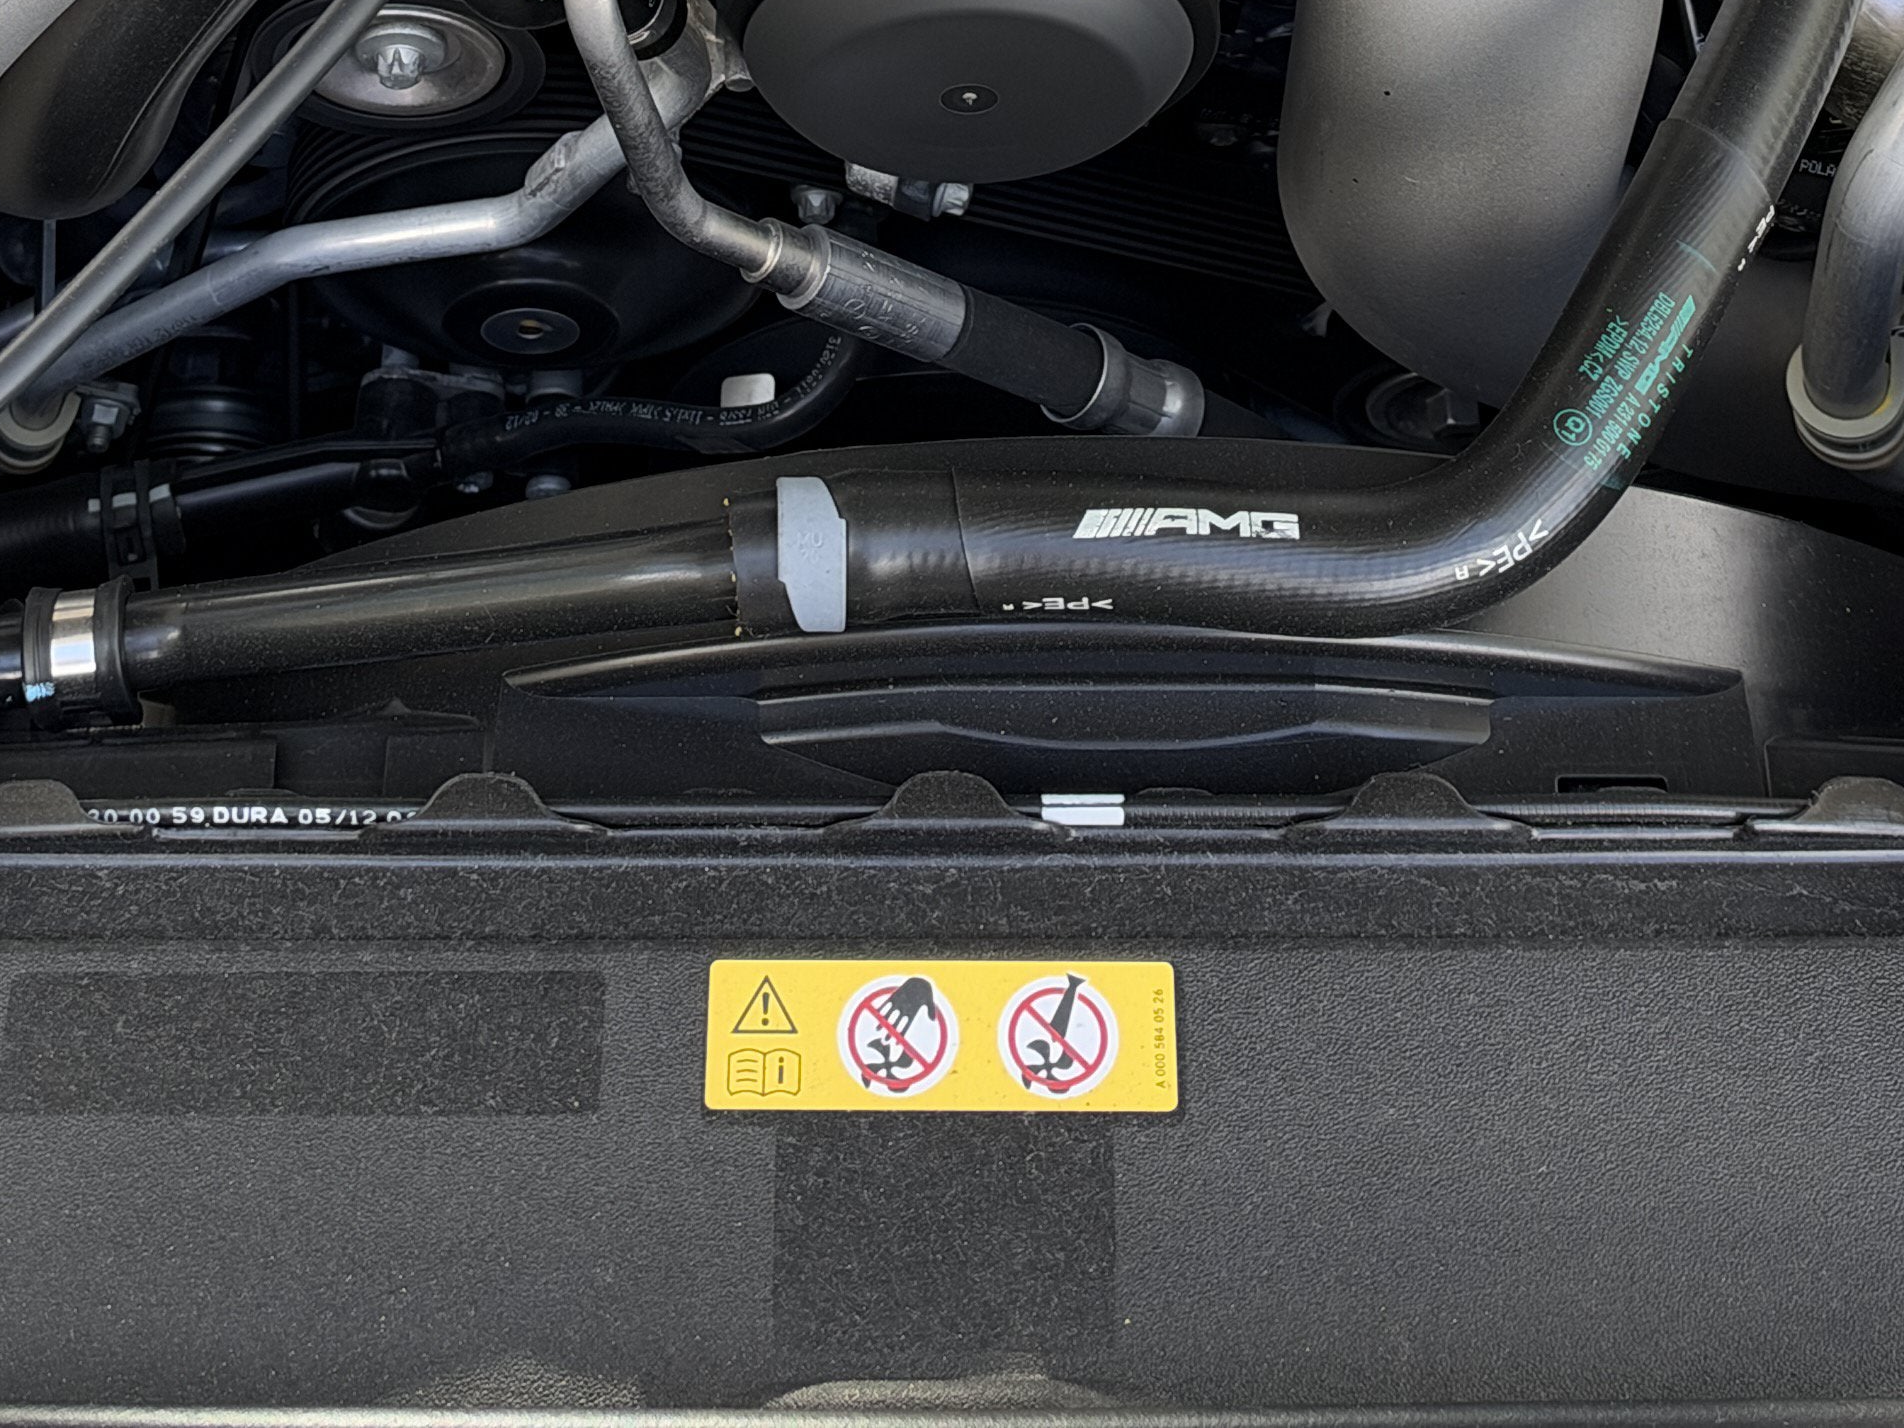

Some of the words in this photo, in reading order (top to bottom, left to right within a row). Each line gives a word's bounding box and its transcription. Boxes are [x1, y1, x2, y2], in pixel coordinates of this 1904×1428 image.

[1615, 343, 1694, 460] TRISTONE
[1151, 507, 1301, 541] AMG
[1151, 987, 1165, 1005] 26
[1152, 1007, 1165, 1024] 05
[1153, 1026, 1166, 1050] 584
[1154, 1052, 1167, 1078] 000
[1155, 1079, 1167, 1090] A
